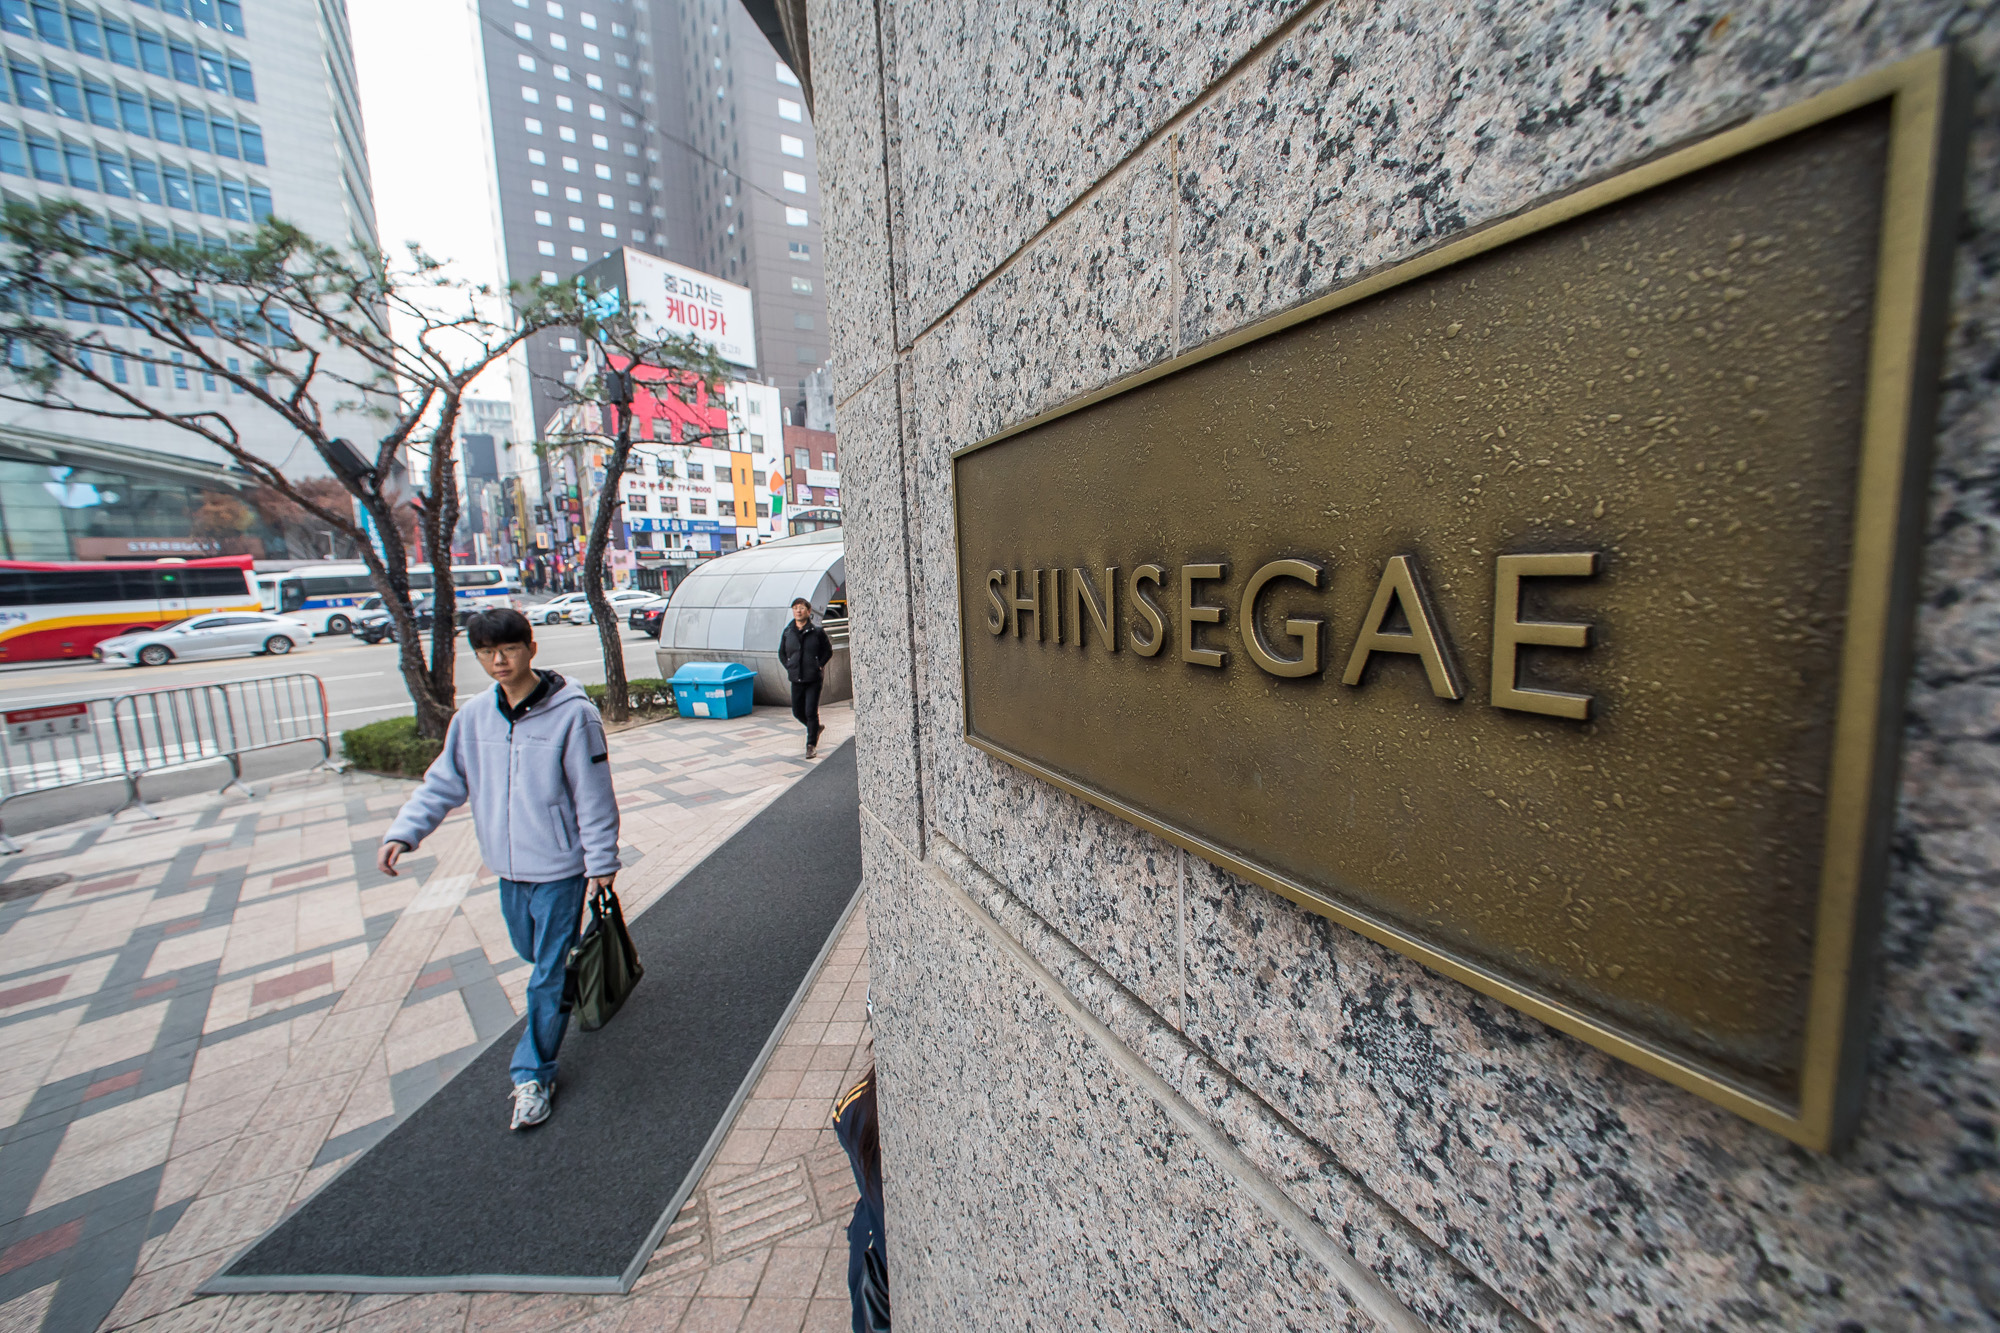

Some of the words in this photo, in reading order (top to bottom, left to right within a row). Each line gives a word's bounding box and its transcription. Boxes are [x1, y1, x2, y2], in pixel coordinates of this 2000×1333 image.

[664, 272, 723, 308] 중고차는
[666, 296, 727, 336] 케이카
[985, 552, 1598, 721] SHINSEGAE
